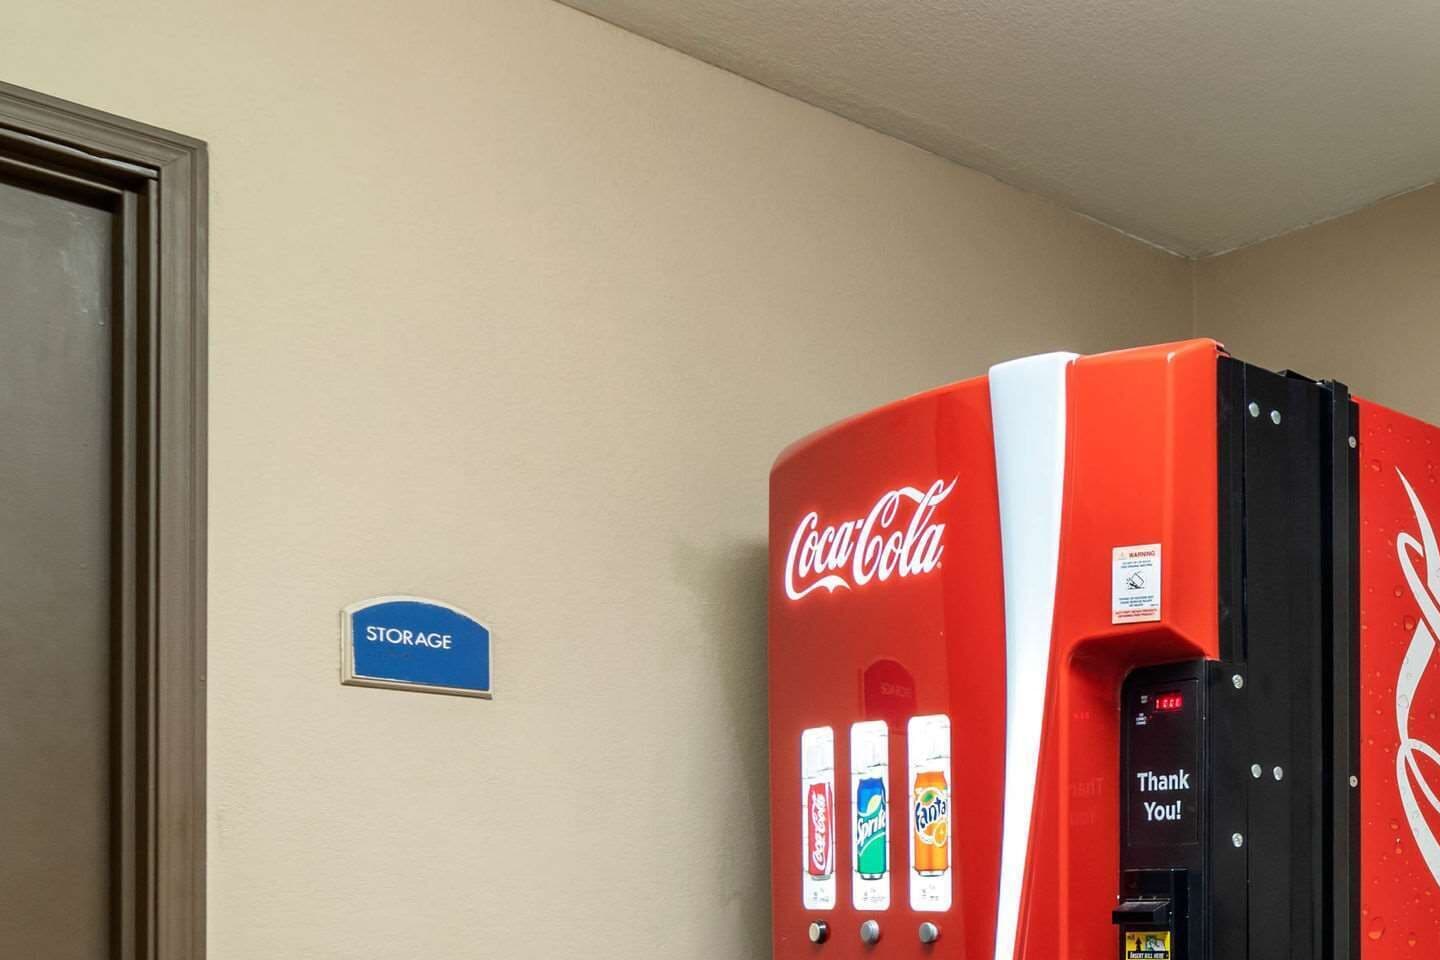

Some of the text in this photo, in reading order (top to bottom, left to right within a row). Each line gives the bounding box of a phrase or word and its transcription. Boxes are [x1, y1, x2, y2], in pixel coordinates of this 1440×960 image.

[784, 472, 960, 601] Coca-Cola
[366, 626, 453, 649] STORAGE
[1137, 769, 1190, 792] Thank
[915, 797, 946, 832] Fanta
[1144, 800, 1182, 821] You!
